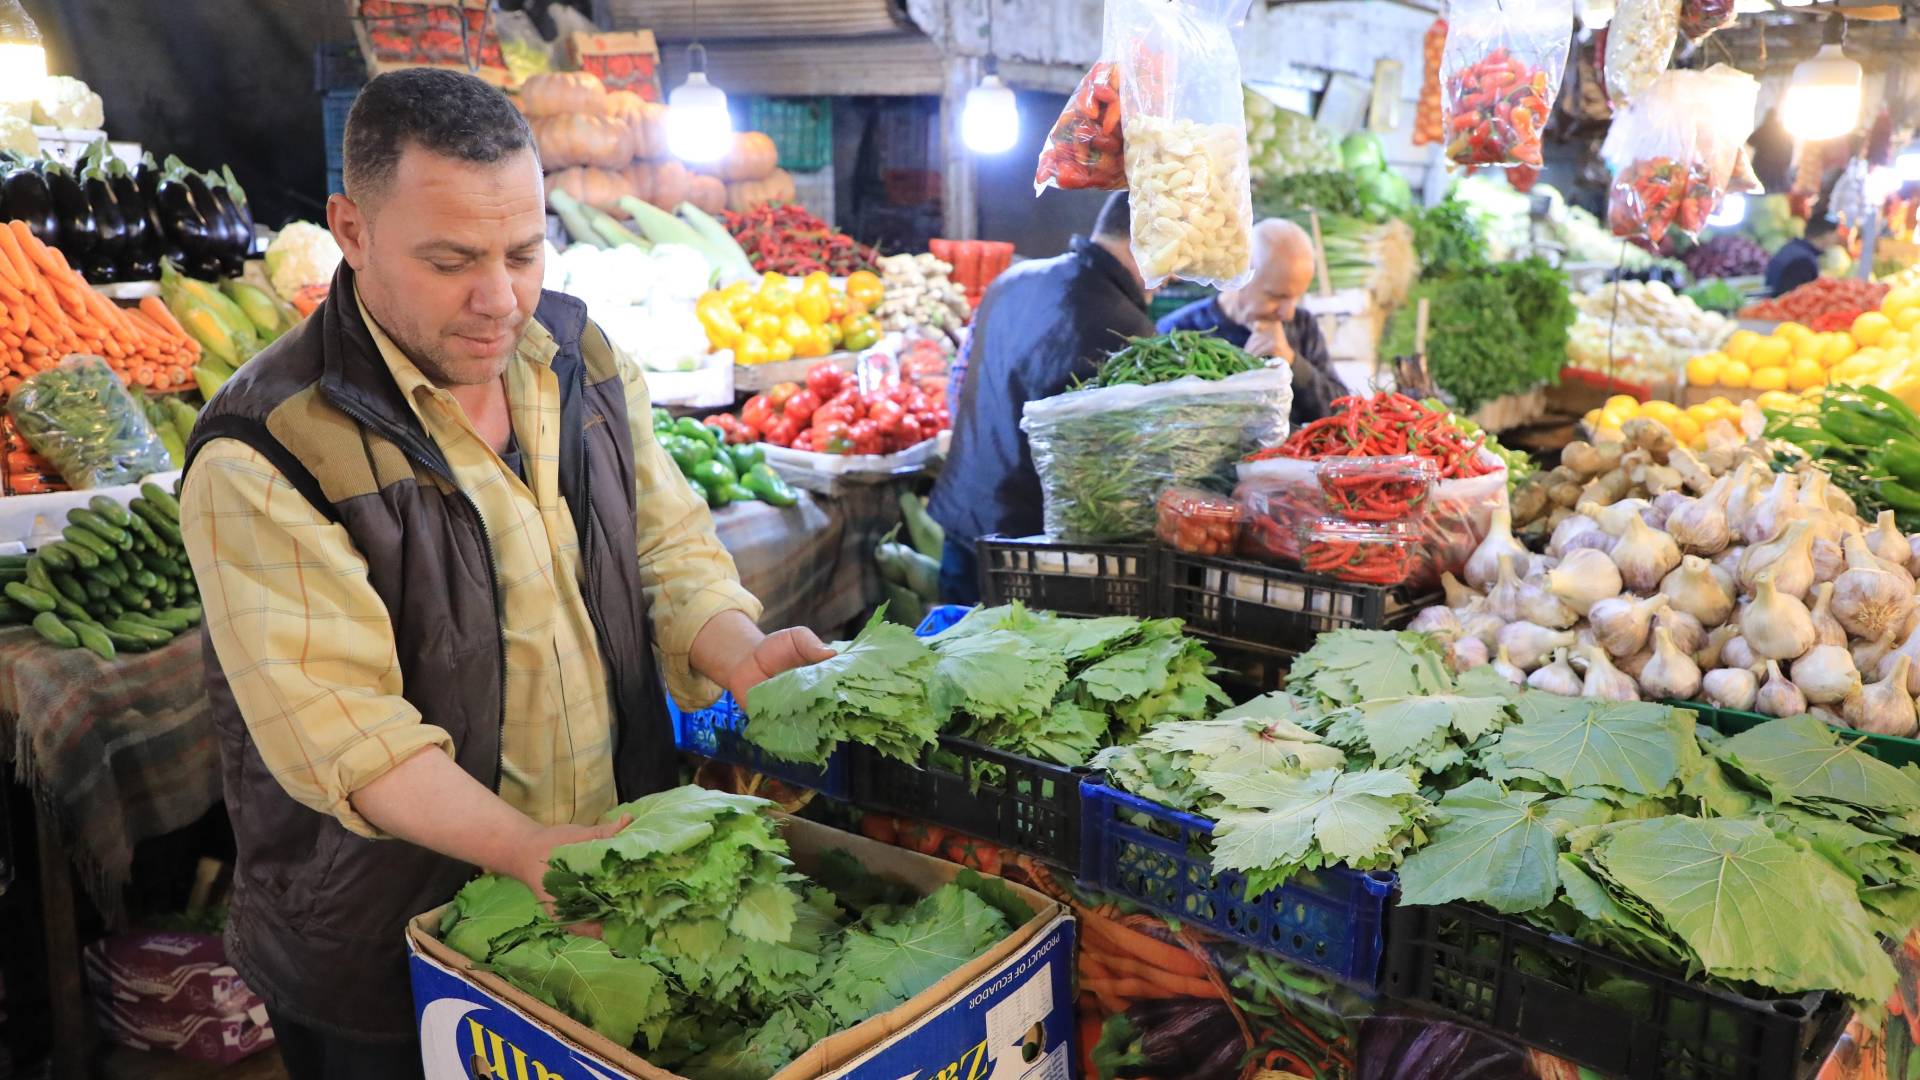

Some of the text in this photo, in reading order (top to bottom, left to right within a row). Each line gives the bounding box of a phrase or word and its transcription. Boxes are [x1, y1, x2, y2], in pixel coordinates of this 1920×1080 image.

[968, 932, 1060, 1010] PRODUCT OF ECUADOR
